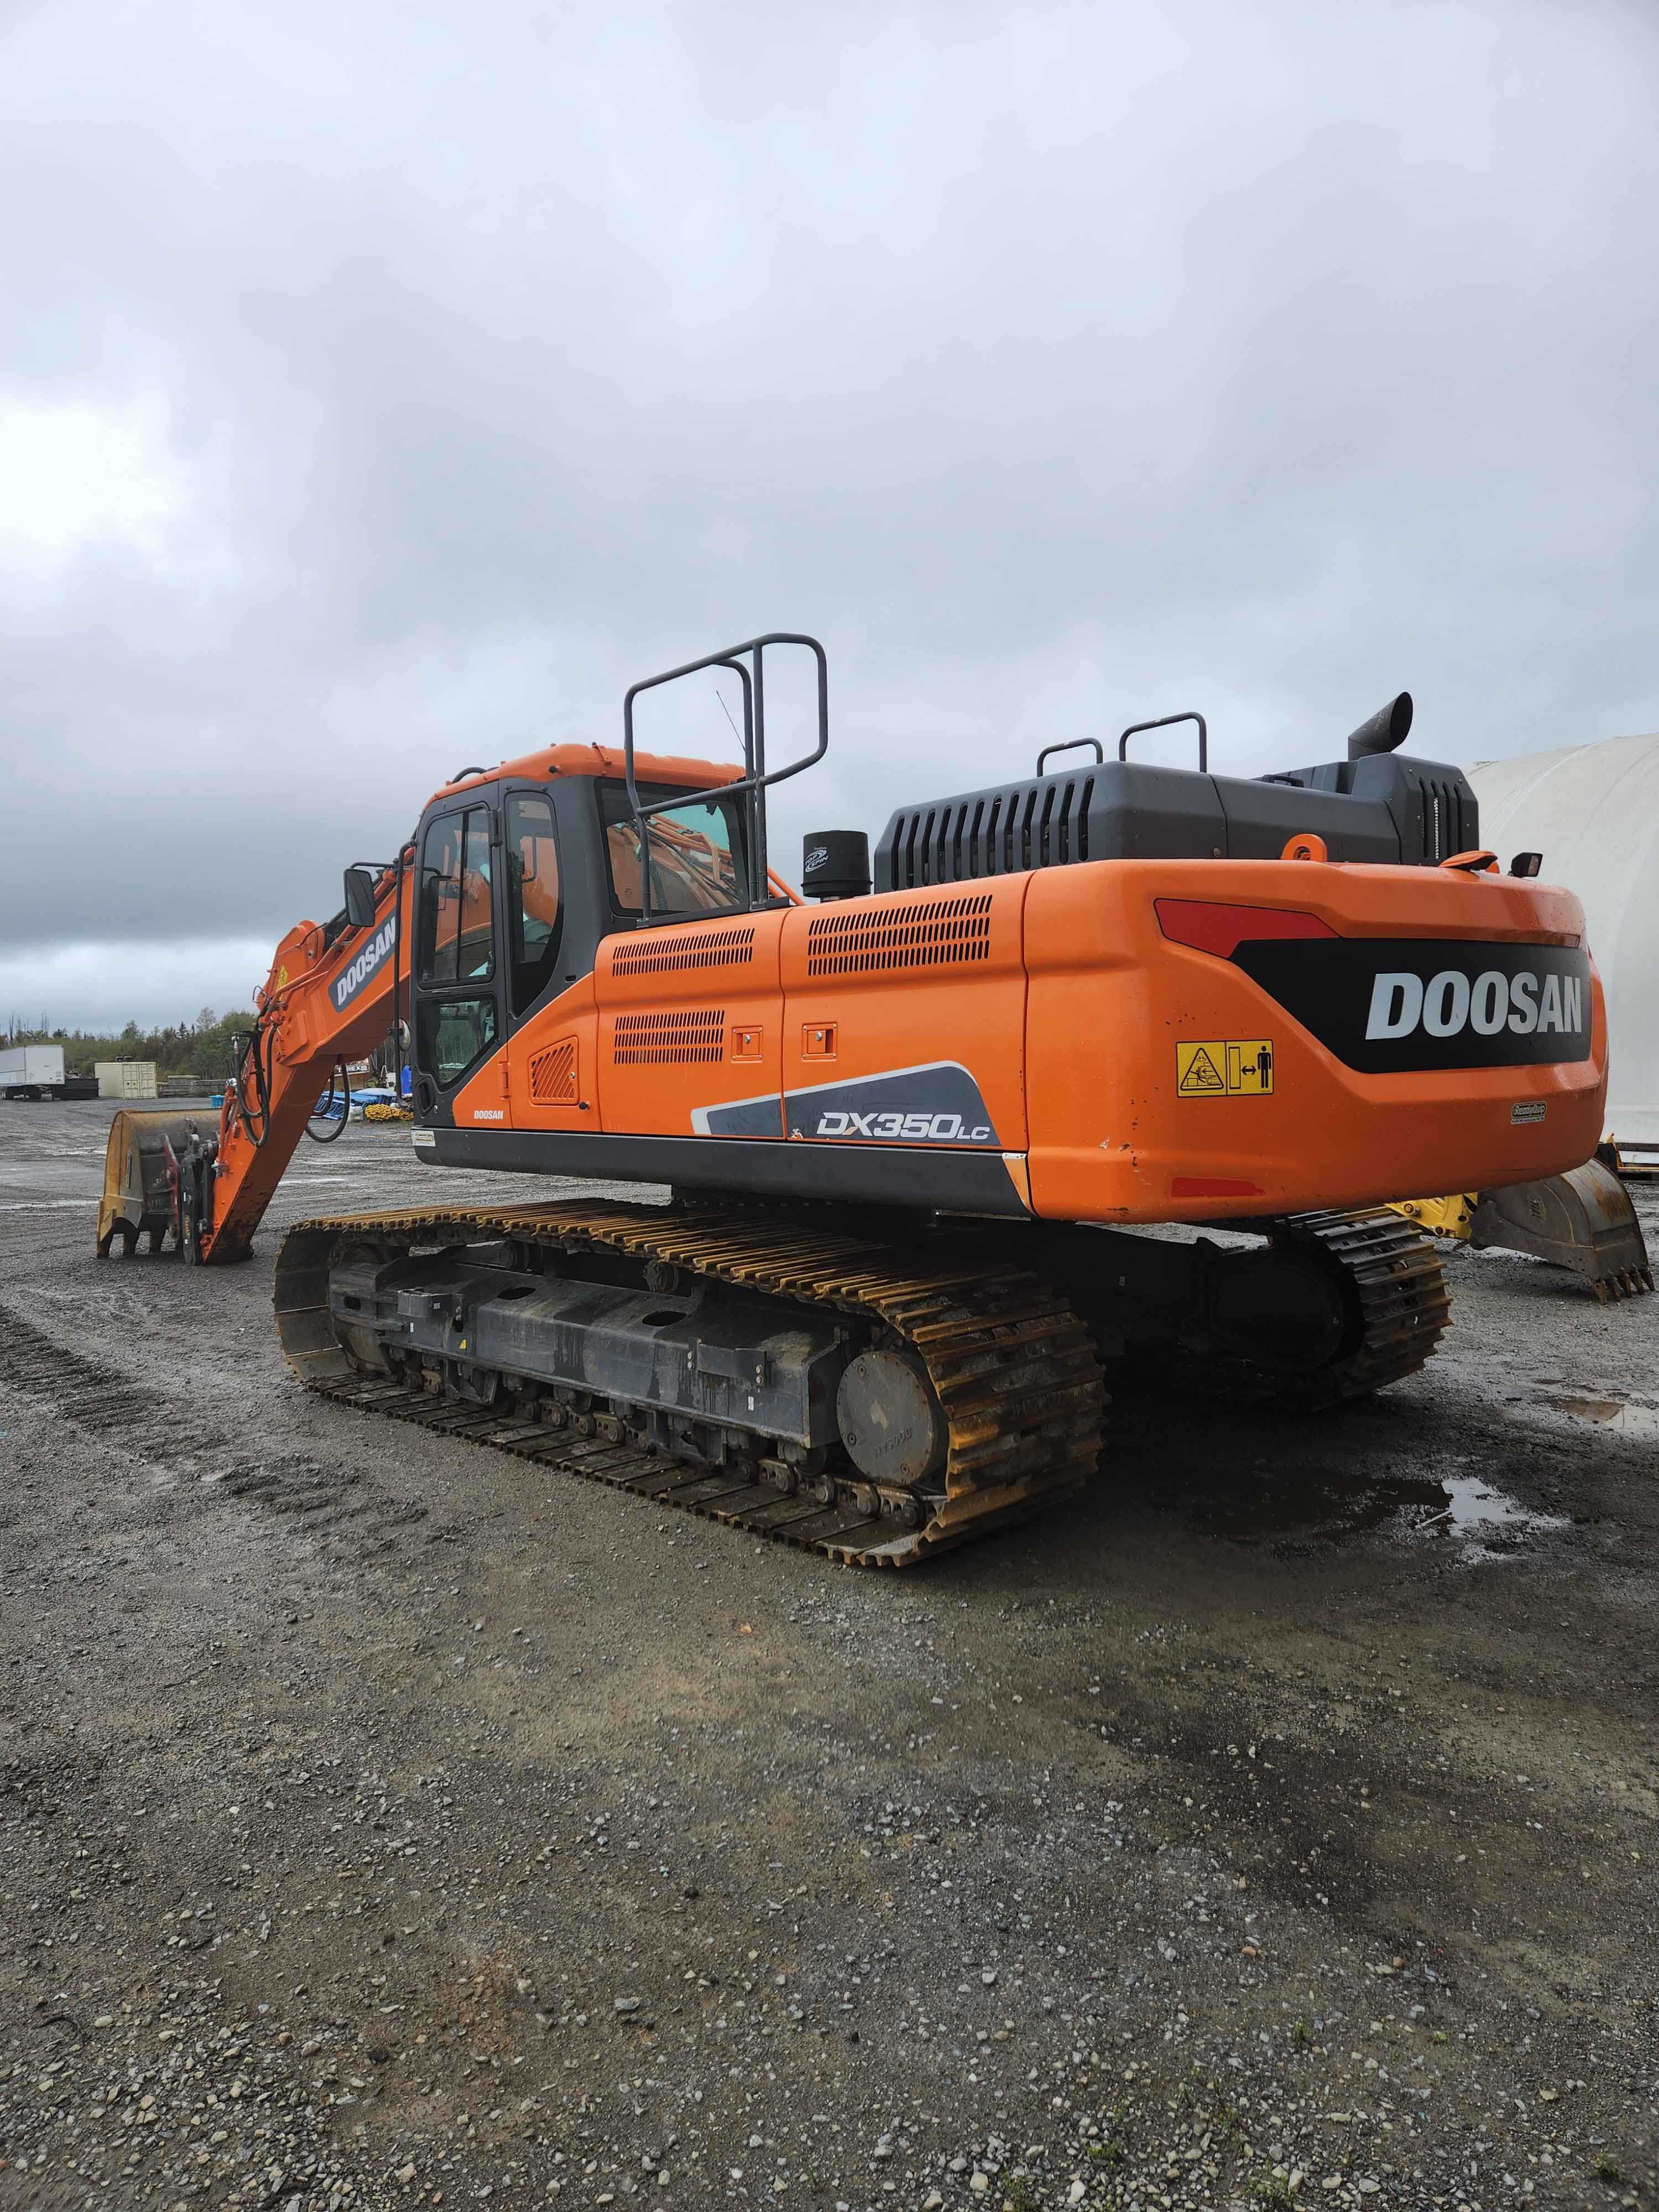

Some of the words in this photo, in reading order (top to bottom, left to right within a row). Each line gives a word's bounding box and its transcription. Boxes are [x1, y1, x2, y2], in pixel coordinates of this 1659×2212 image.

[337, 916, 396, 1006] DOOSAN
[1365, 971, 1582, 1040] DOOSAN
[474, 1110, 504, 1119] DOOSAN
